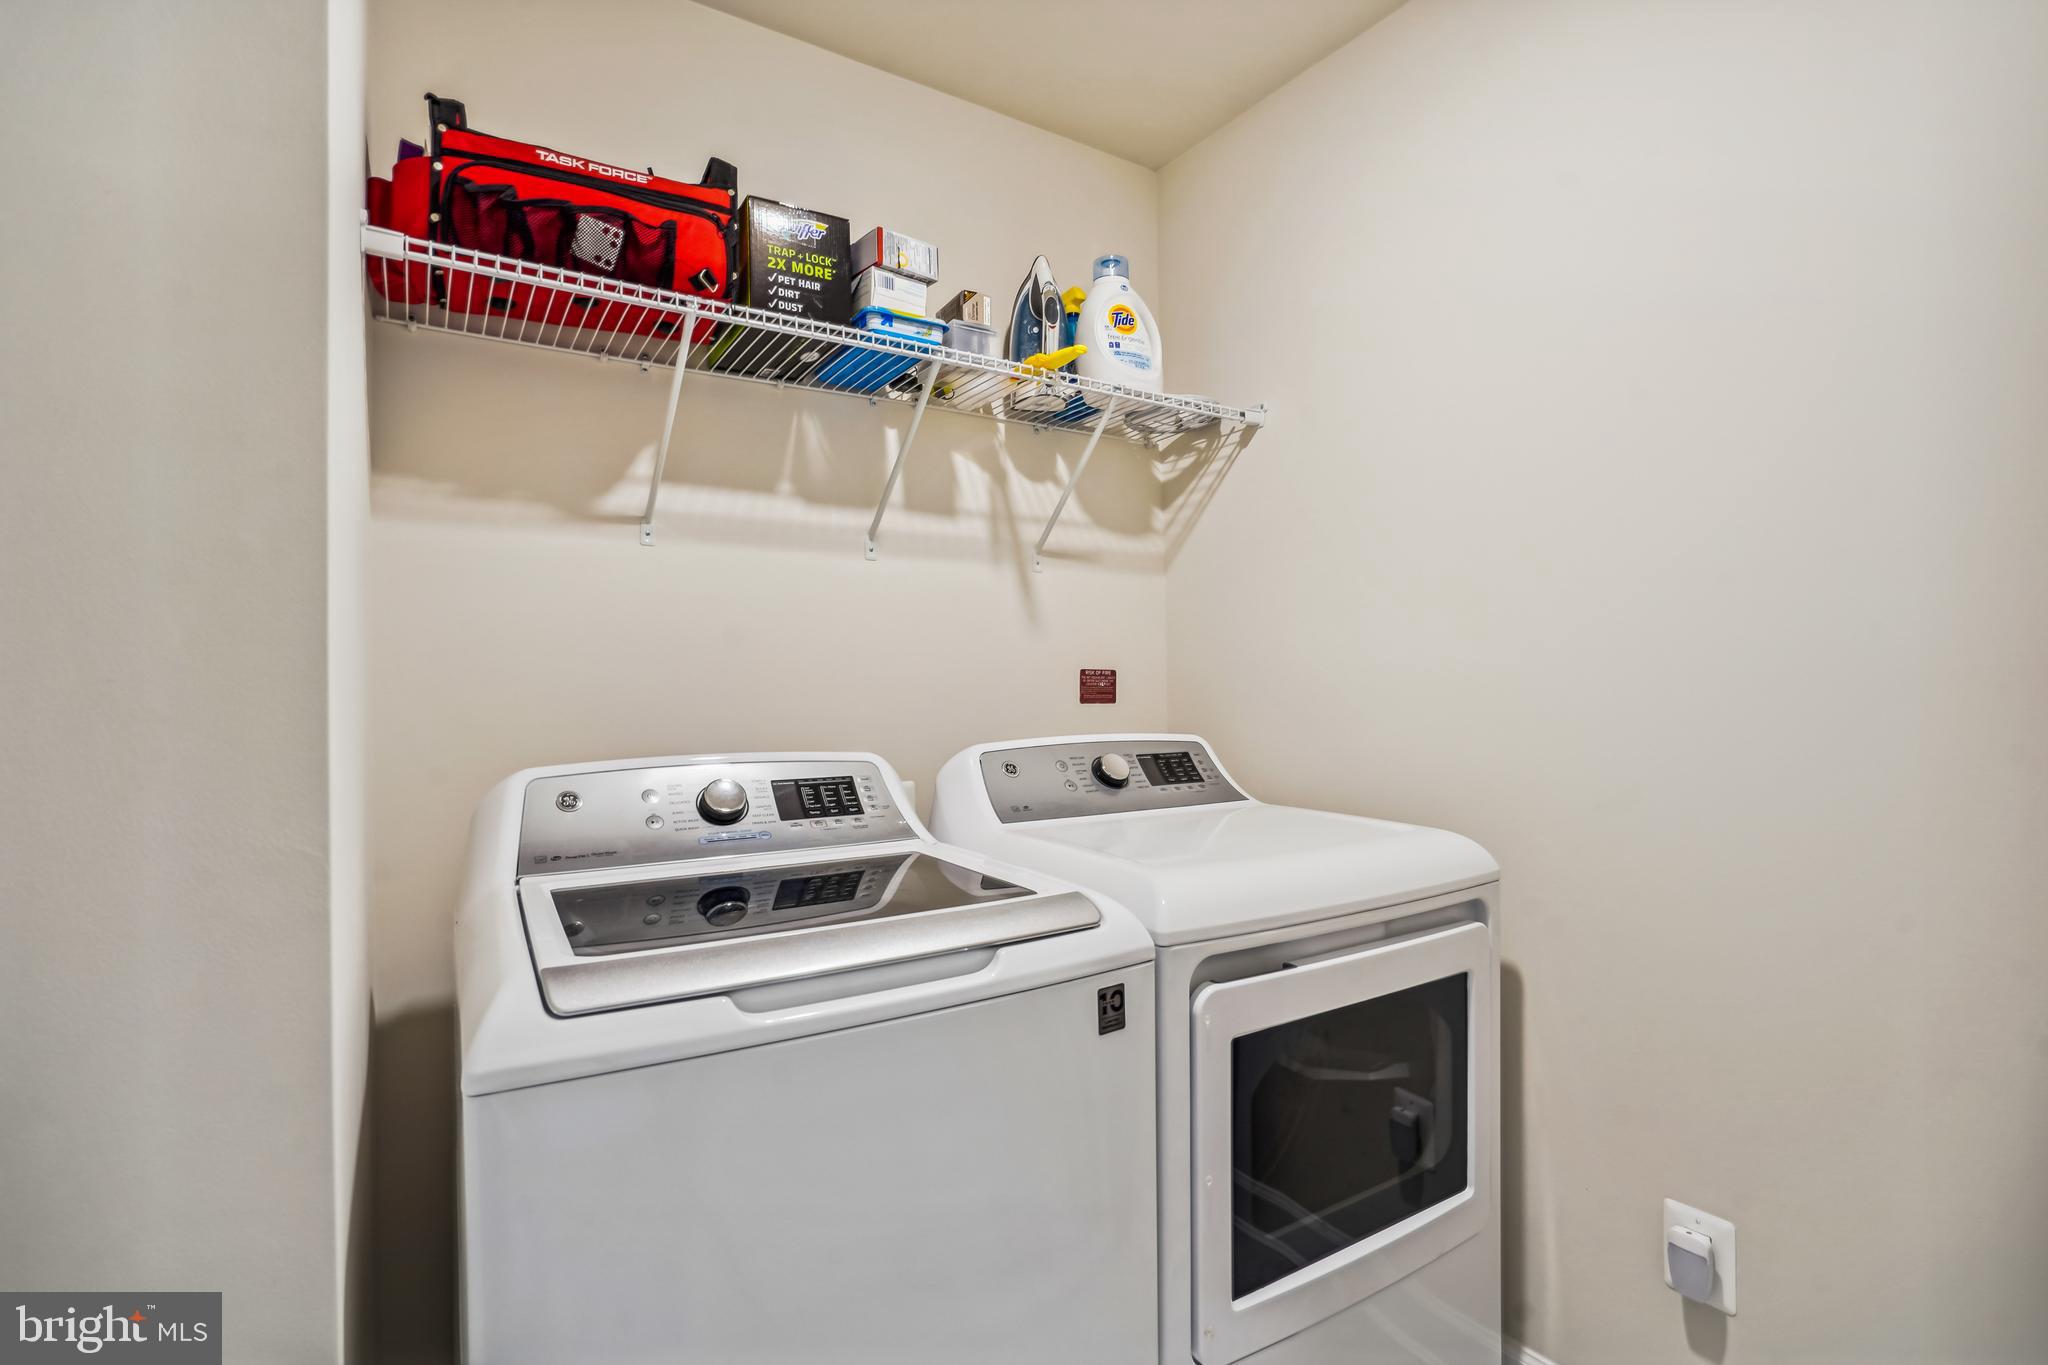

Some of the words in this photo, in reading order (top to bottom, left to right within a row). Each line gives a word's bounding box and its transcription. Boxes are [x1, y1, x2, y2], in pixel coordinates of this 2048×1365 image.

[535, 149, 585, 170] TASK
[588, 162, 648, 184] FORCE
[767, 244, 796, 258] TRAP
[767, 256, 787, 271] 2X
[778, 275, 796, 285] PET
[799, 279, 821, 291] HAIR
[778, 287, 801, 299] DIRT
[778, 300, 803, 312] DUST
[1112, 312, 1135, 328] Tide
